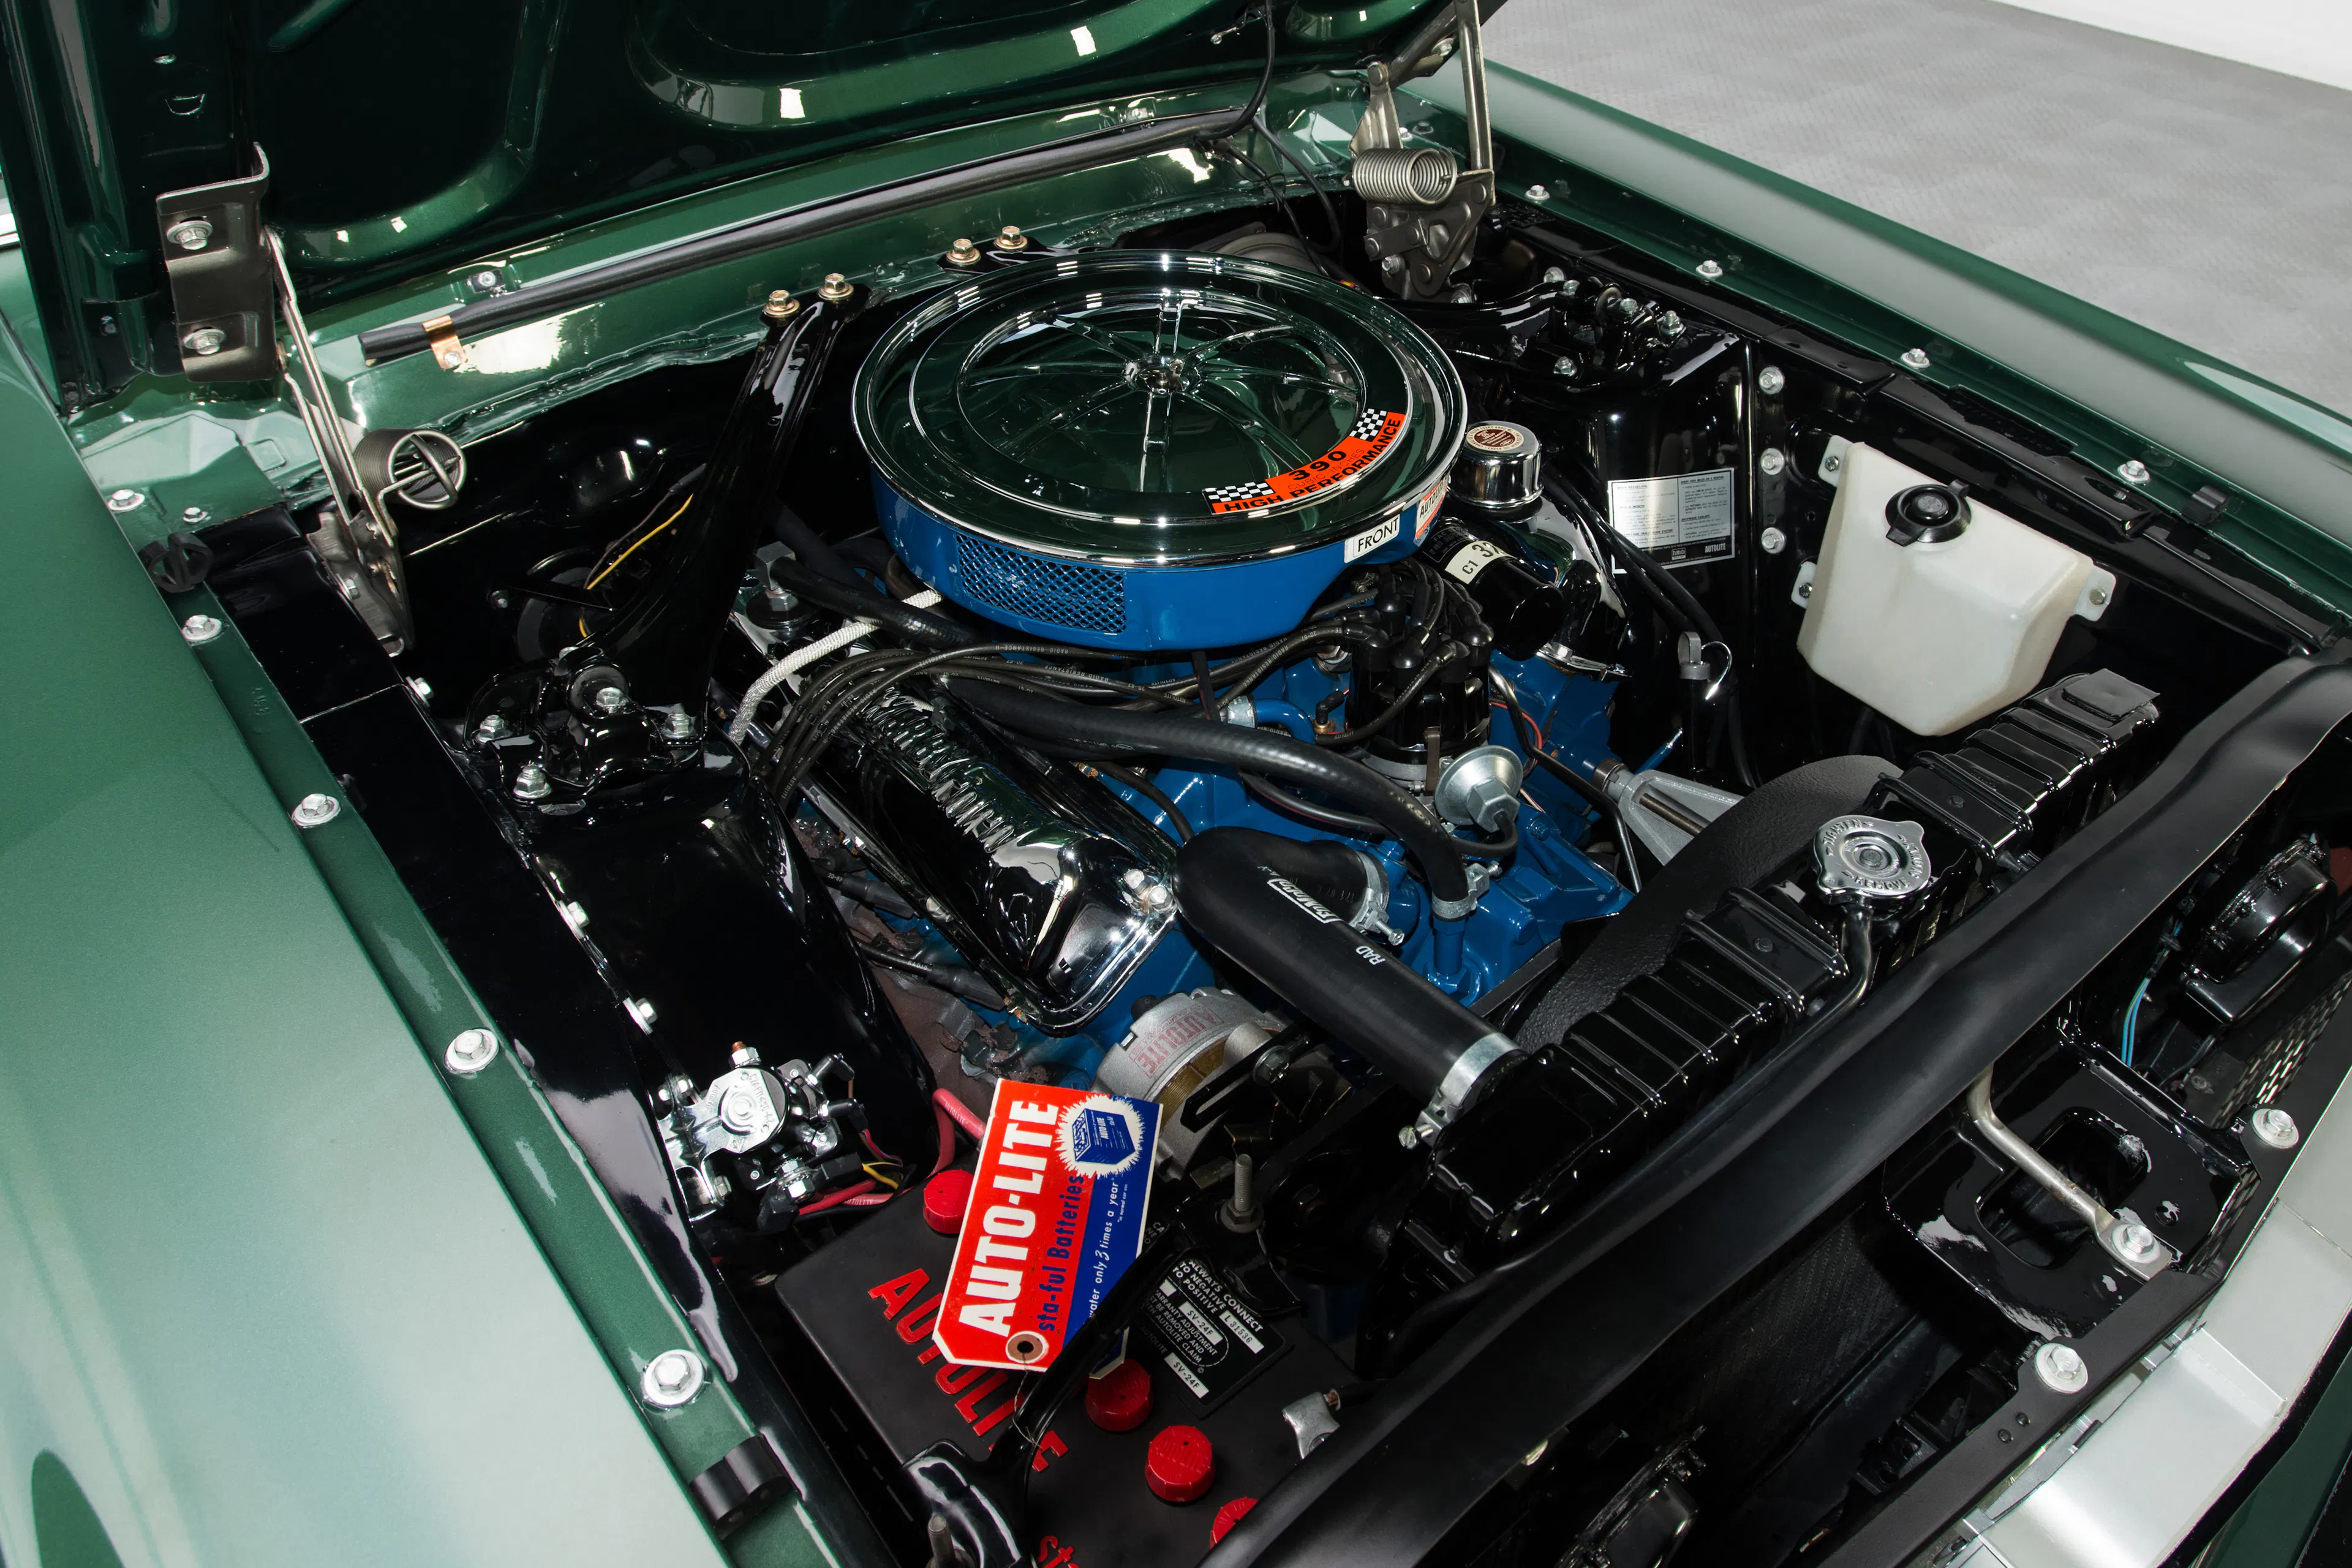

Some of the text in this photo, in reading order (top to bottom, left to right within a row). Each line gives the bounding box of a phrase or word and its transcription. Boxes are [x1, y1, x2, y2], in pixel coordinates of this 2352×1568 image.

[1224, 495, 1286, 512] HIGH
[1289, 418, 1401, 498] PERFORMANCE
[1287, 448, 1365, 491] CUBIC INCHES
[1288, 450, 1347, 481] 390
[1357, 518, 1399, 552] FRONT
[1705, 543, 1726, 553] AUTOLITE
[1462, 560, 1479, 575] C1
[919, 653, 947, 667] AUTOLITE
[1272, 645, 1289, 660] RADIO
[1045, 665, 1086, 677] RESISTANCE
[1088, 674, 1109, 682] RADIO
[1243, 659, 1272, 688] RESISTANCE
[1164, 693, 1186, 704] AUTOLITE
[1822, 818, 1863, 845] TIGHTEN
[1855, 876, 1911, 890] REMOVE
[1355, 945, 1385, 965] RAD
[1136, 1009, 1218, 1074] AUTOLITE
[944, 1101, 967, 1125] AUTOLITE
[959, 1101, 1059, 1337] AUTO-LITE
[1099, 1222, 1112, 1248] times
[1038, 1175, 1084, 1332] sta-ful Batteries
[1095, 1250, 1110, 1261] 3
[1093, 1262, 1107, 1284] only
[1180, 1262, 1227, 1310] TO NEGATIVE
[1172, 1267, 1218, 1314] TO POSITIVE
[1188, 1261, 1264, 1333] ALWAYS CONNECT
[1155, 1289, 1218, 1356] ARRANTY ADJUSTMENT
[1155, 1302, 1164, 1312] BE
[1163, 1311, 1191, 1340] REMOVED
[1189, 1340, 1205, 1354] AND
[1186, 1310, 1213, 1336] SV-24F
[1155, 1314, 1183, 1343] AUTOLITE
[1182, 1342, 1203, 1363] CLAIM
[1173, 1361, 1200, 1389] SV-24F
